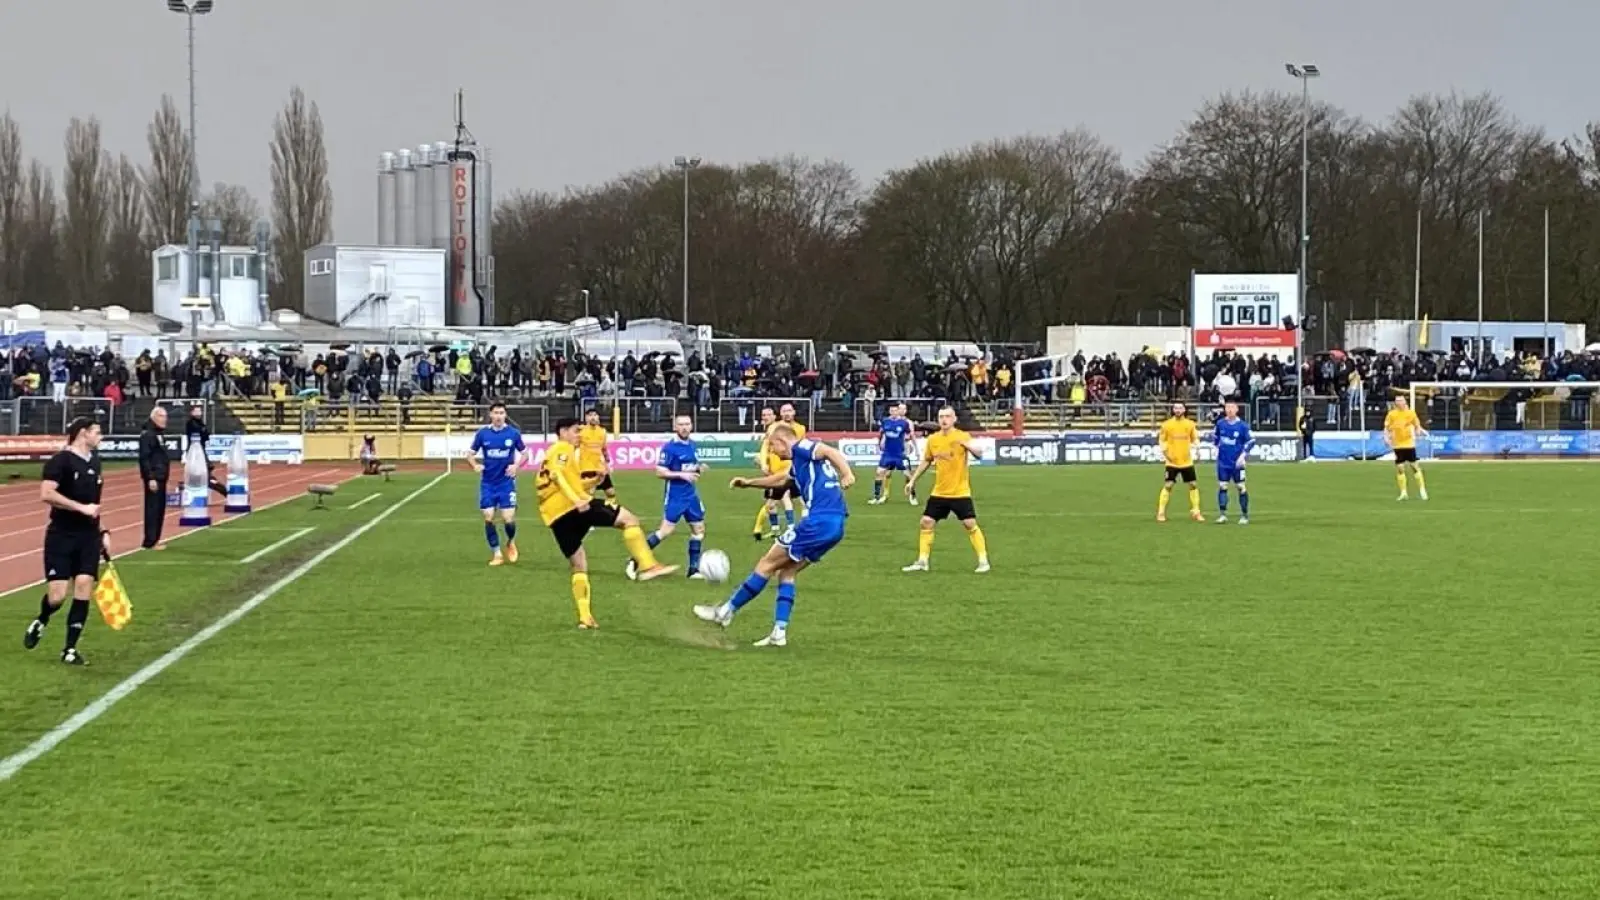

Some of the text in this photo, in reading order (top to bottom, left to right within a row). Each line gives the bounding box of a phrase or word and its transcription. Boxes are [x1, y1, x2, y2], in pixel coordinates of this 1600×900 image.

[696, 447, 731, 457] URIER
[1118, 444, 1161, 461] cape
[1249, 439, 1298, 461] apelli
